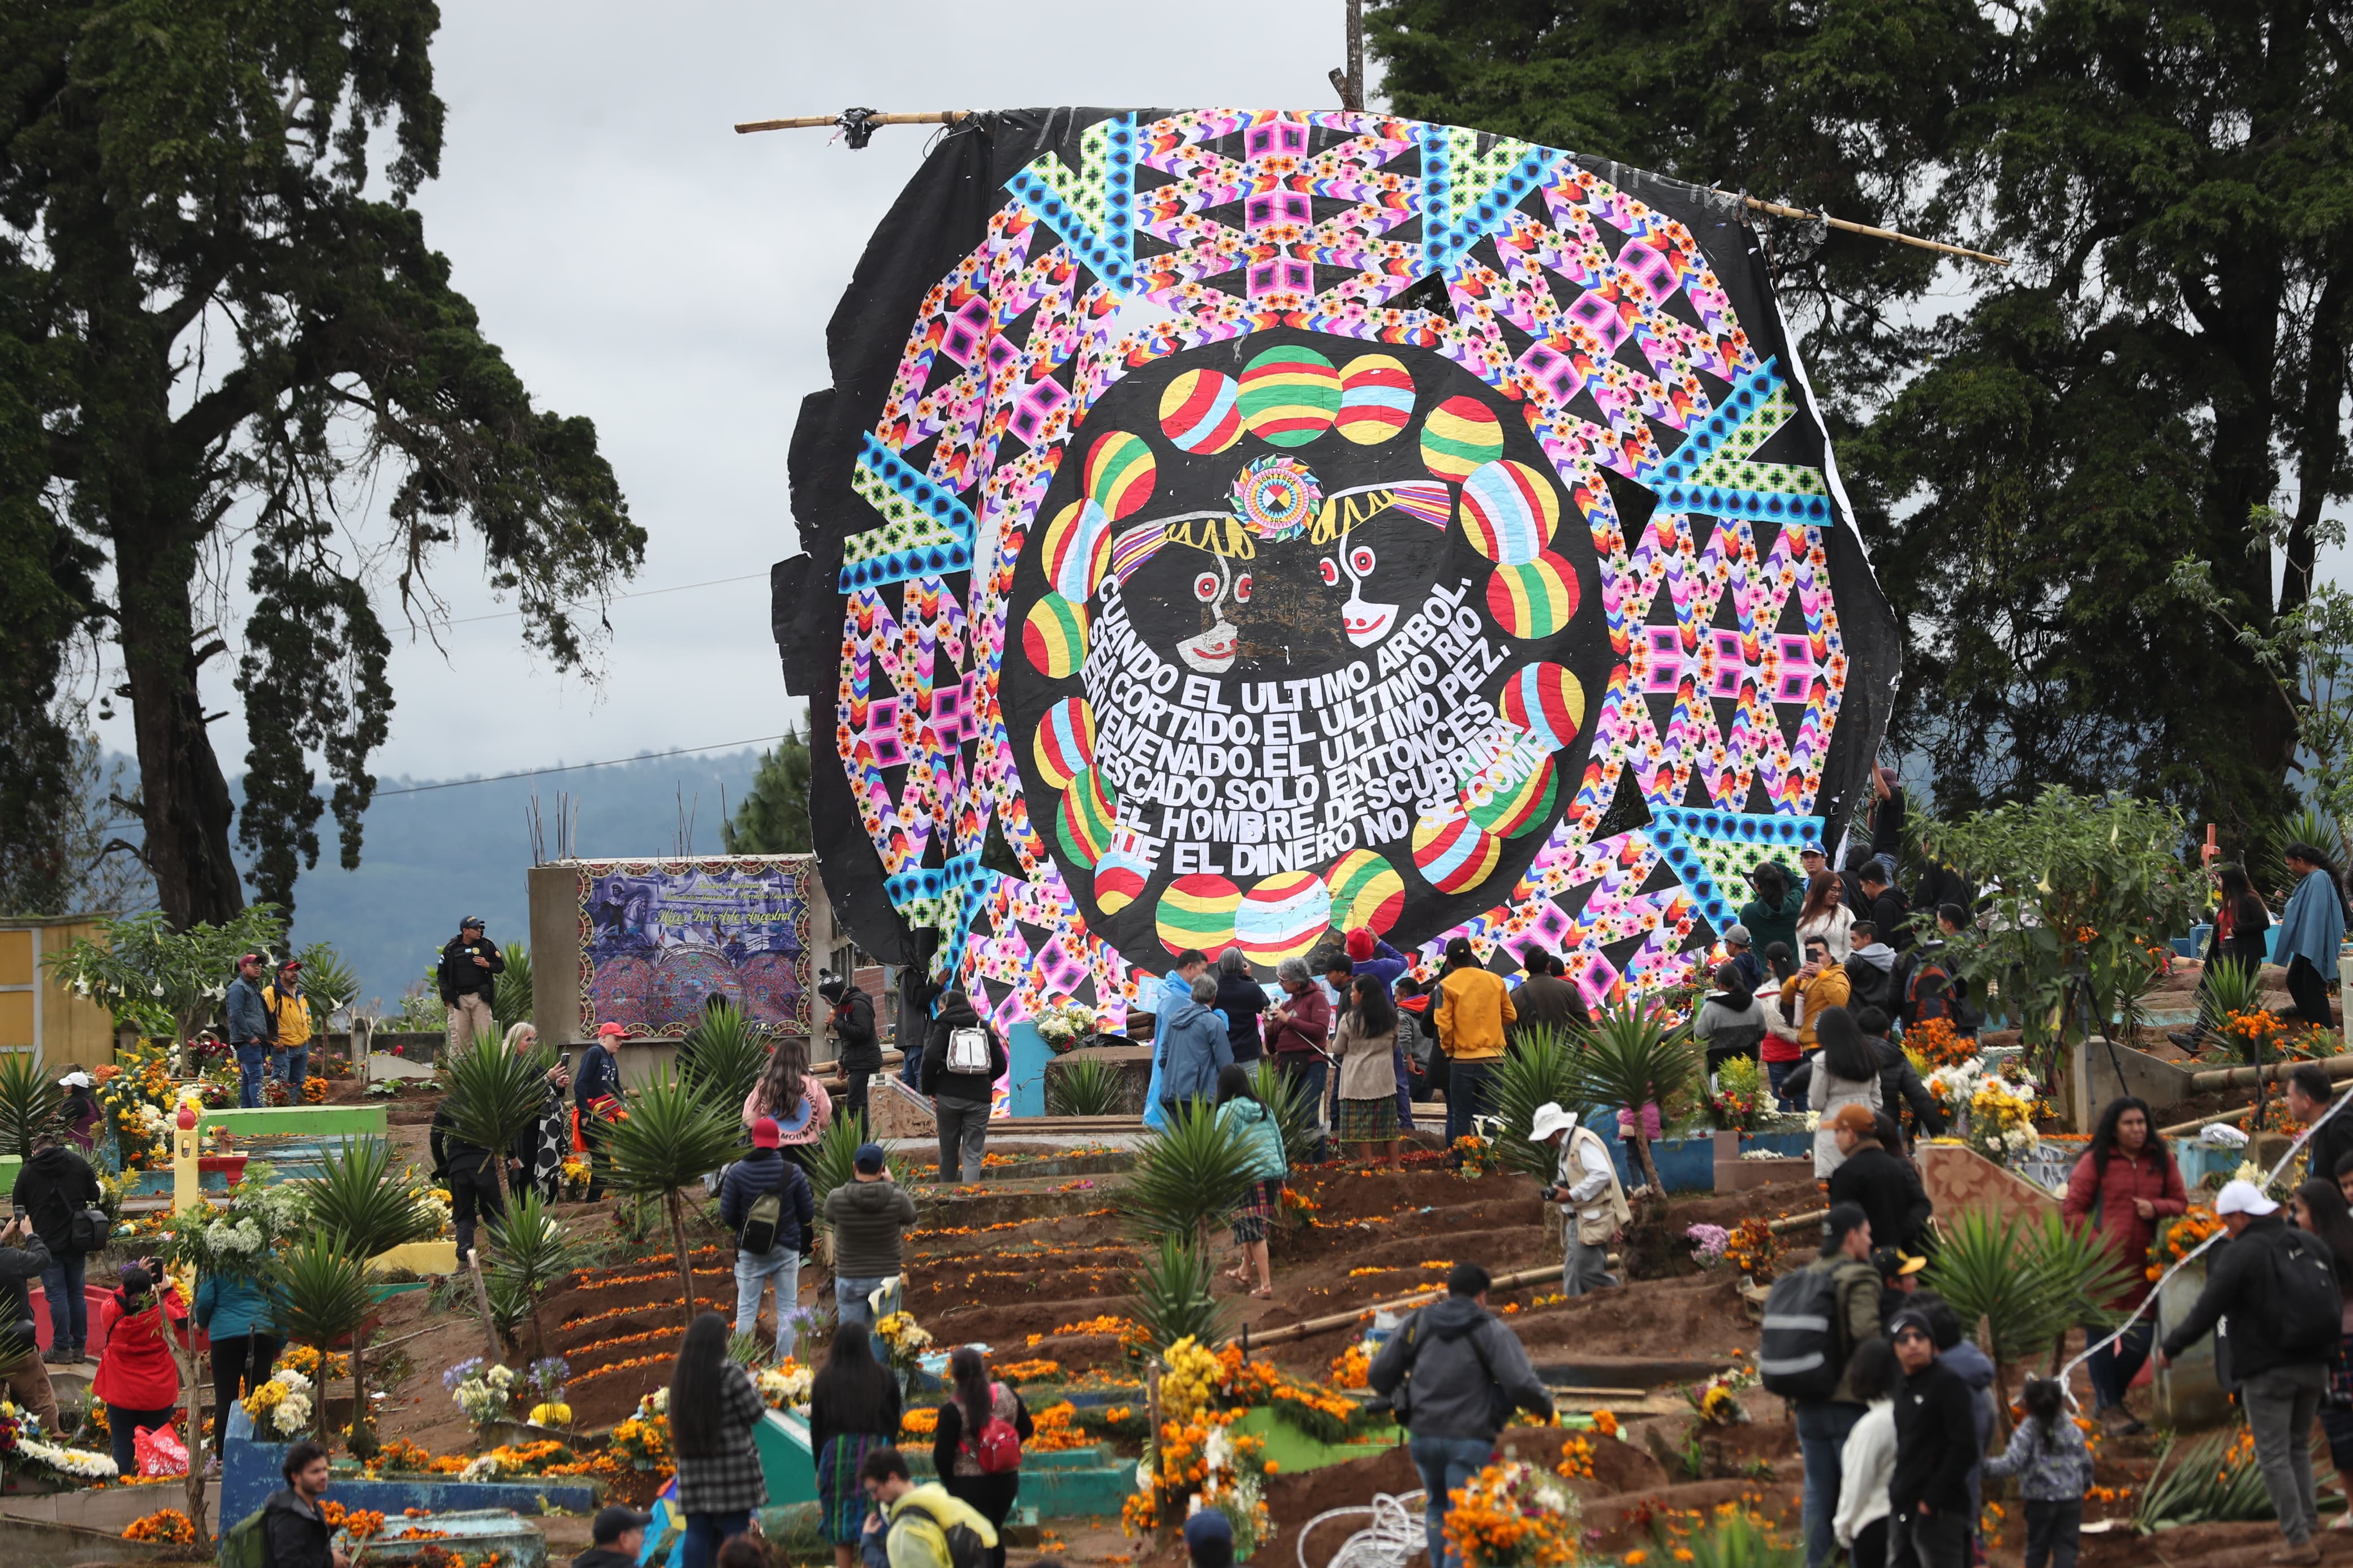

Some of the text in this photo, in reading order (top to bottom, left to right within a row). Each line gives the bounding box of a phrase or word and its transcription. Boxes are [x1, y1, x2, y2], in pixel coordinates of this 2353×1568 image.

[1257, 473, 1296, 486] SANTIAGO
[1089, 617, 1118, 689] SEA
[1262, 712, 1317, 746] EL
[1317, 654, 1438, 737] ULTIMO
[1430, 606, 1482, 668] RIO
[1098, 573, 1179, 694] CUANDO
[1180, 673, 1232, 714] EL
[1241, 660, 1371, 714] ULTIMO
[1114, 792, 1152, 832] EL
[1324, 716, 1525, 831] DESCUBRIRA
[1225, 774, 1320, 812] SOLO
[1326, 694, 1494, 801] ENTONCES
[1262, 744, 1315, 778] EL
[1319, 692, 1439, 769] ULTIMO
[1109, 726, 1555, 876] QUE EL DINERO NO SE COME
[655, 905, 797, 927] Hijos Del Arte Ancestral
